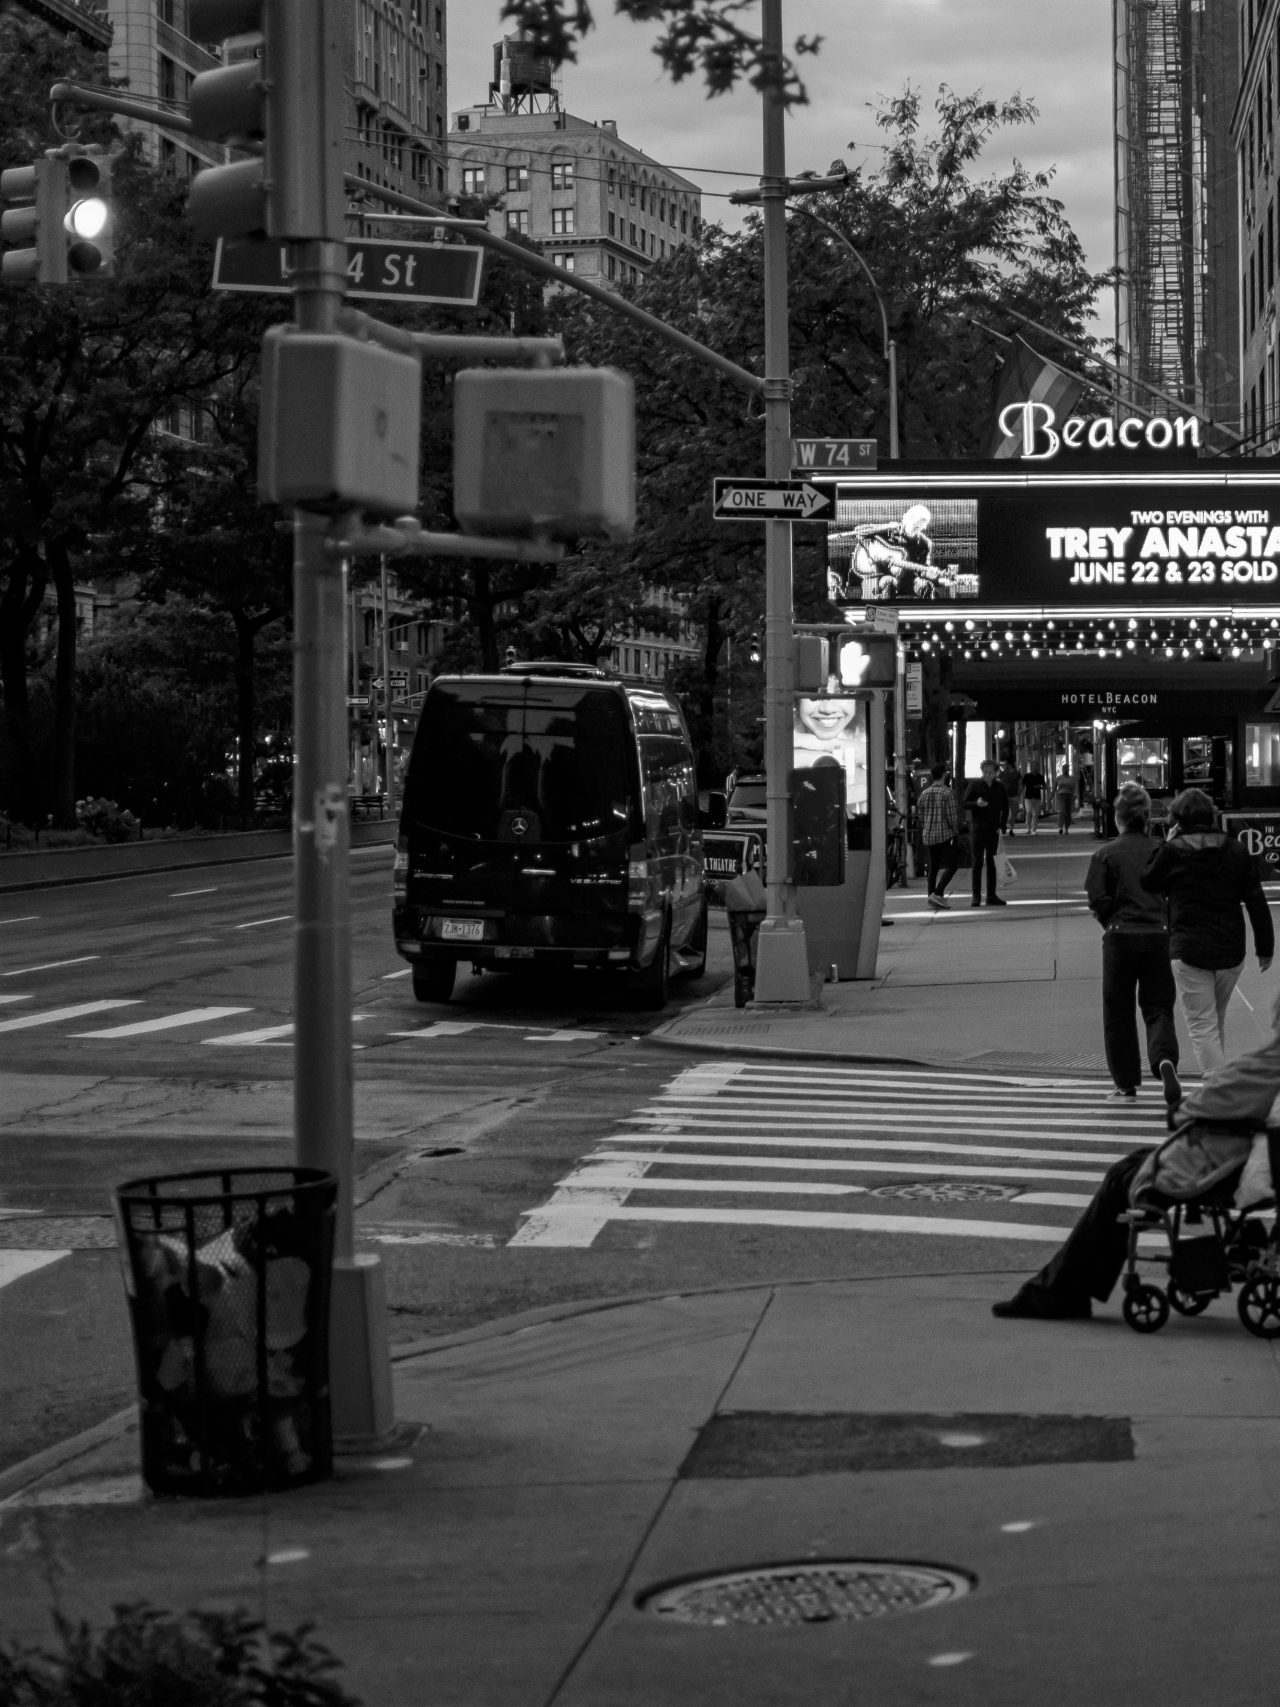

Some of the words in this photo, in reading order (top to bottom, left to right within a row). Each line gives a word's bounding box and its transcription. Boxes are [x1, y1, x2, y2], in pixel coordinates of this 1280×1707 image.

[345, 251, 364, 284] 4
[381, 254, 417, 287] St
[999, 400, 1200, 459] Beacon
[800, 443, 816, 466] W
[825, 443, 850, 466] 74
[859, 444, 871, 456] ST
[732, 492, 766, 507] ONE
[783, 493, 818, 508] WAY
[1131, 510, 1164, 524] TWO
[1166, 510, 1232, 524] EVENINGS
[1234, 510, 1269, 524] WITH
[1046, 526, 1133, 558] TREY
[1070, 561, 1125, 583] JUNE
[1131, 561, 1159, 582] 22
[1165, 561, 1183, 582] &
[1187, 561, 1215, 582] 23
[1221, 560, 1278, 582] SOLD
[709, 857, 736, 872] THEATRE
